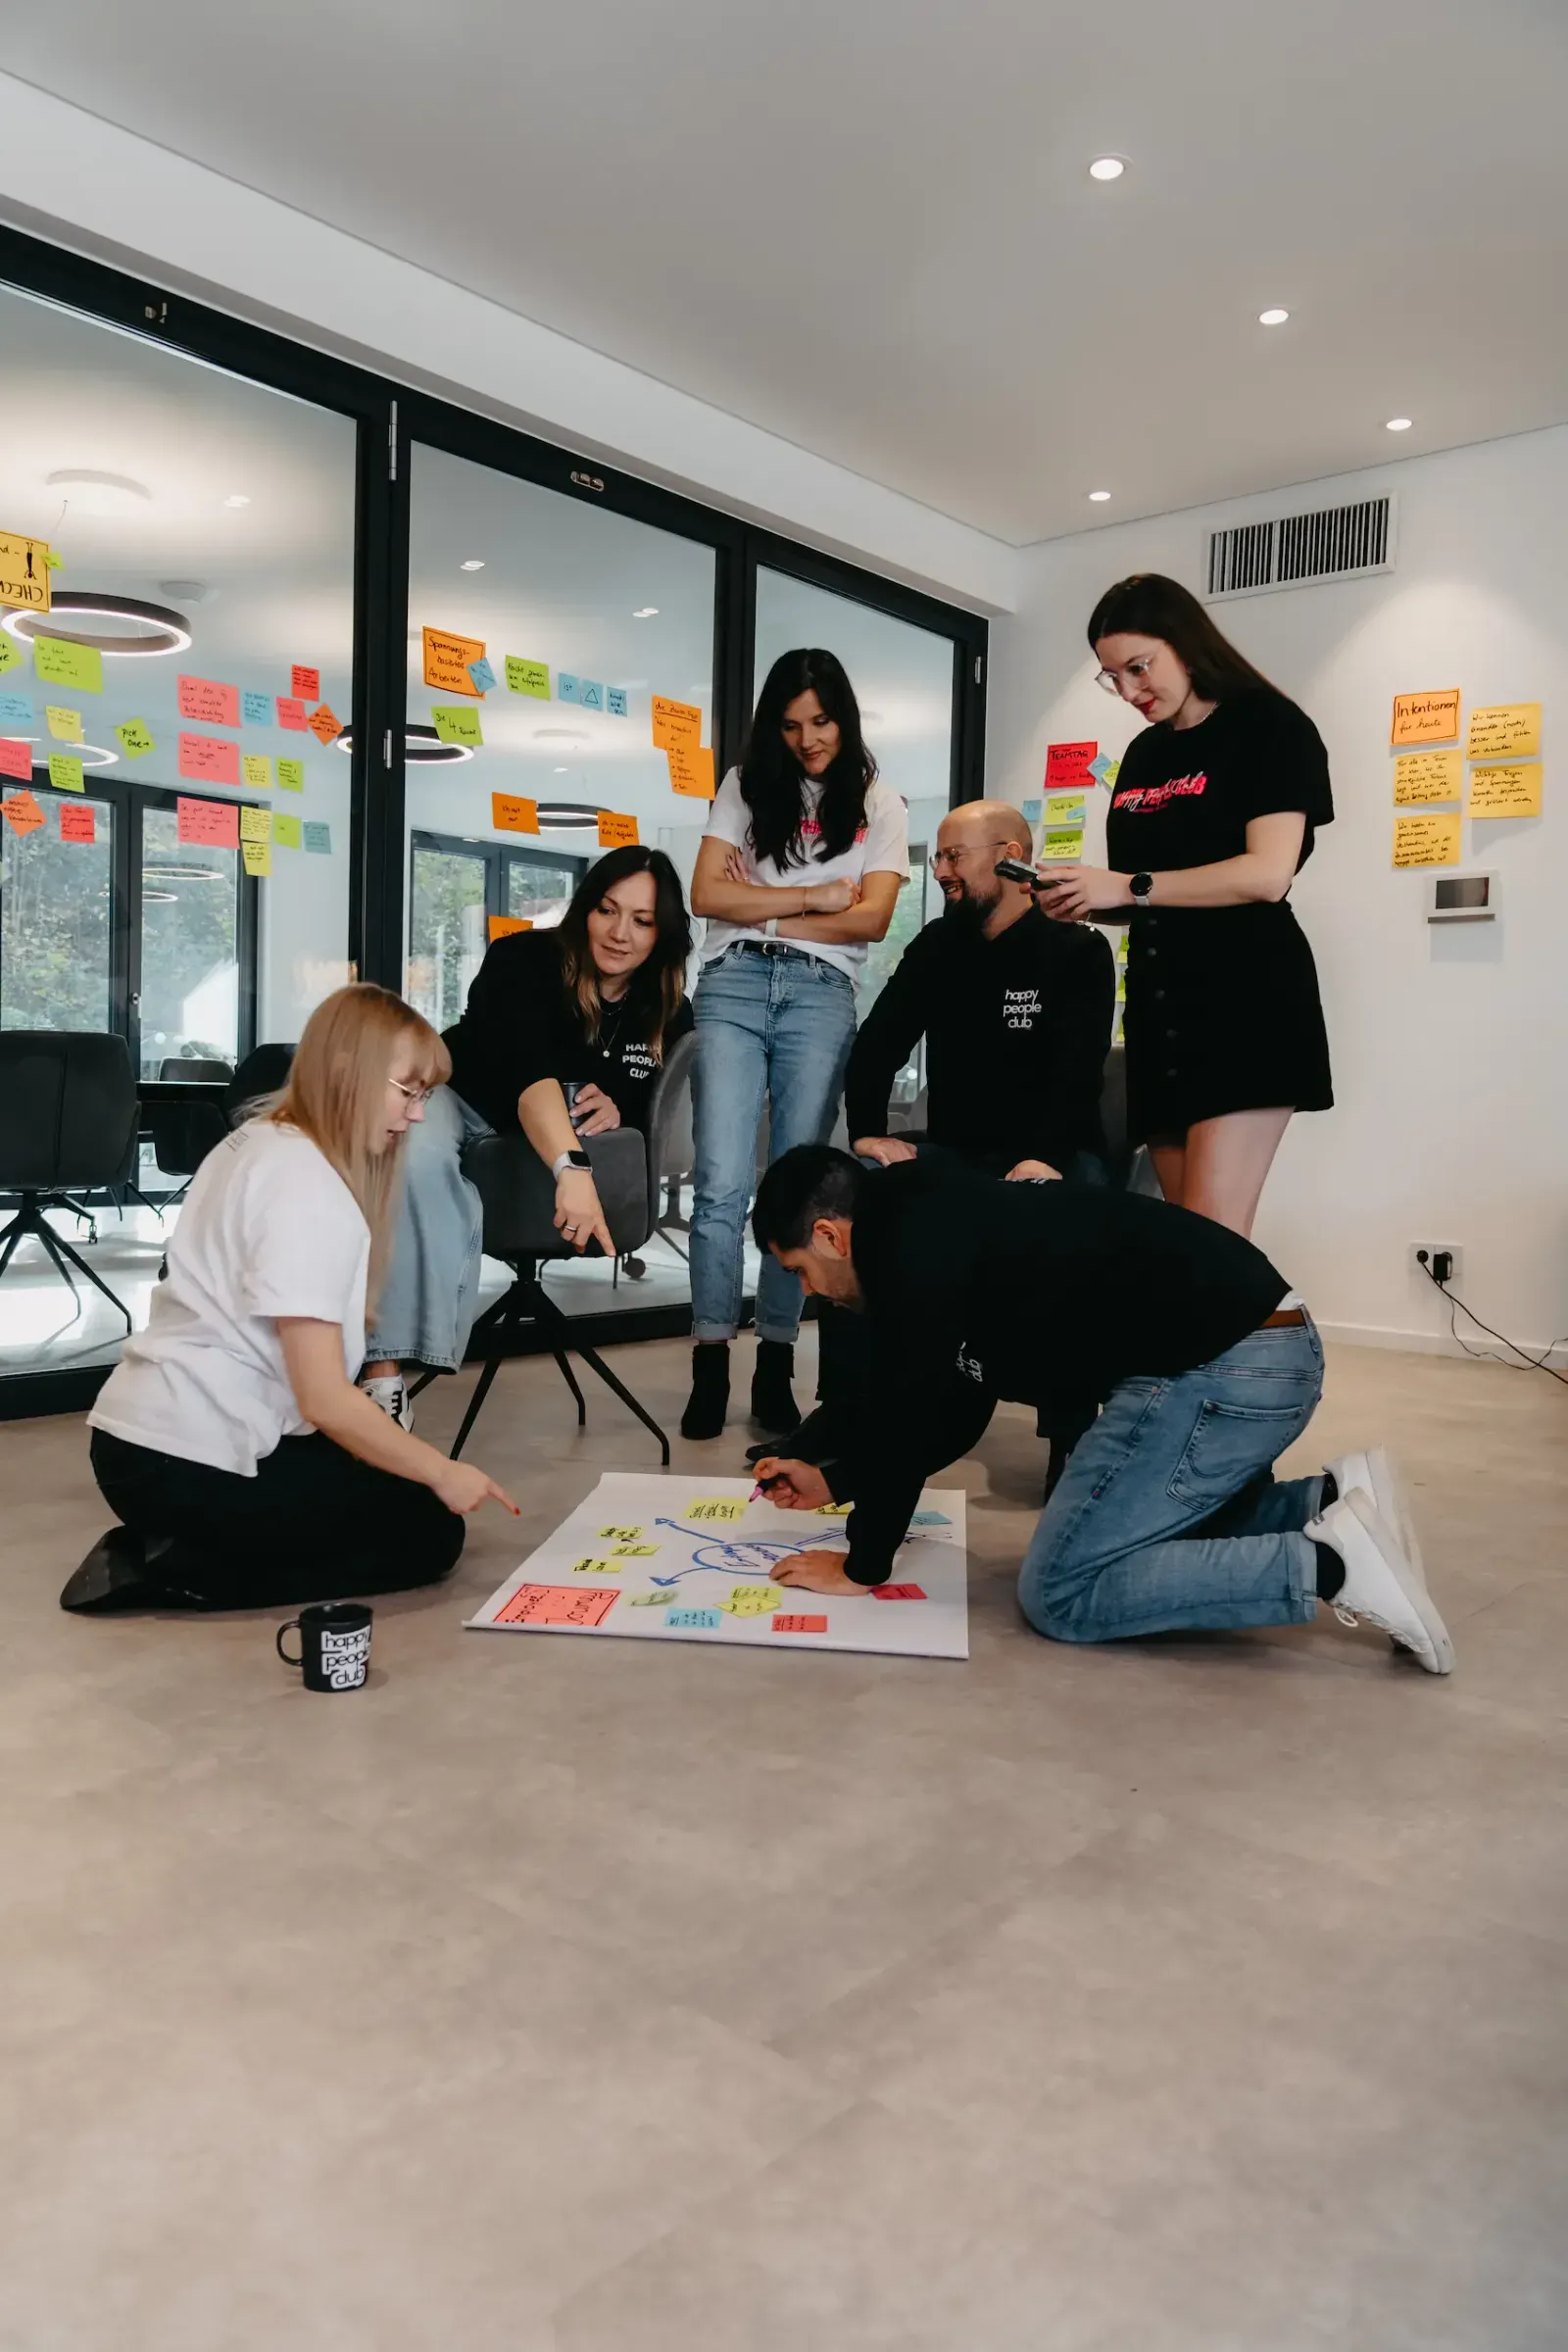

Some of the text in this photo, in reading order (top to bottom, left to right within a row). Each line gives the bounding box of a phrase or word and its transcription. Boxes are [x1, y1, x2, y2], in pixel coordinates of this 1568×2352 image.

[1396, 700, 1456, 718] Intentionen
[1415, 717, 1443, 730] heute
[1004, 989, 1040, 1005] happy
[1003, 1004, 1043, 1020] people
[1007, 1015, 1033, 1029] club
[625, 1044, 648, 1053] HAP
[325, 1650, 369, 1672] peop
[335, 1669, 365, 1686] club
